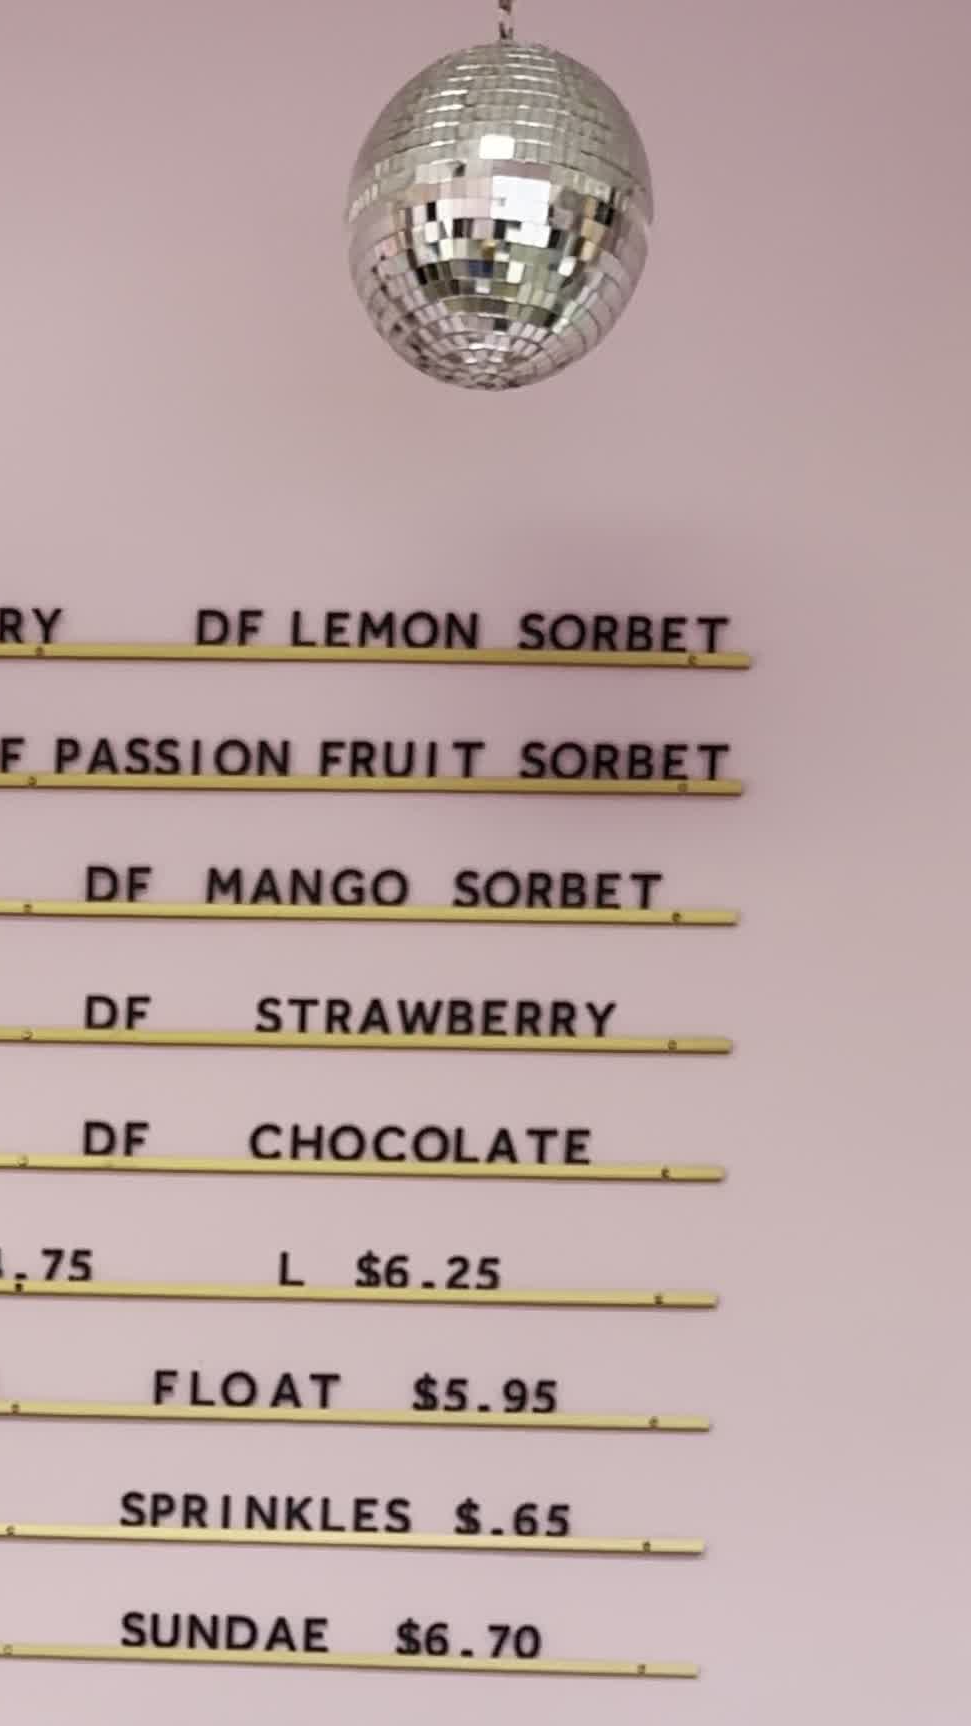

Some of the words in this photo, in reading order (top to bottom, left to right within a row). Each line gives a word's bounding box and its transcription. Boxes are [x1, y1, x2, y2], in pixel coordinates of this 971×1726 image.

[196, 609, 265, 645] DF
[291, 611, 479, 650] LEMON
[517, 613, 730, 654] SORBET
[55, 738, 290, 777] PASSION
[320, 741, 485, 779] FRUIT
[519, 742, 731, 782] SORBET
[86, 866, 152, 902] DF
[206, 868, 409, 906] MANGO
[453, 870, 662, 910] SORBET
[85, 995, 151, 1030] DF
[255, 997, 617, 1037] STRAWBERRY
[83, 1121, 149, 1157] DF
[249, 1123, 591, 1165] CHOCOLATE
[279, 1252, 304, 1287] L
[356, 1251, 500, 1290] $6.25
[154, 1370, 340, 1409] FLOAT
[413, 1373, 557, 1414] $5.95
[120, 1491, 412, 1533] SPRINKLES
[455, 1498, 570, 1537] $.65
[121, 1612, 329, 1653] SUNDAE
[396, 1618, 542, 1659] $6.70
